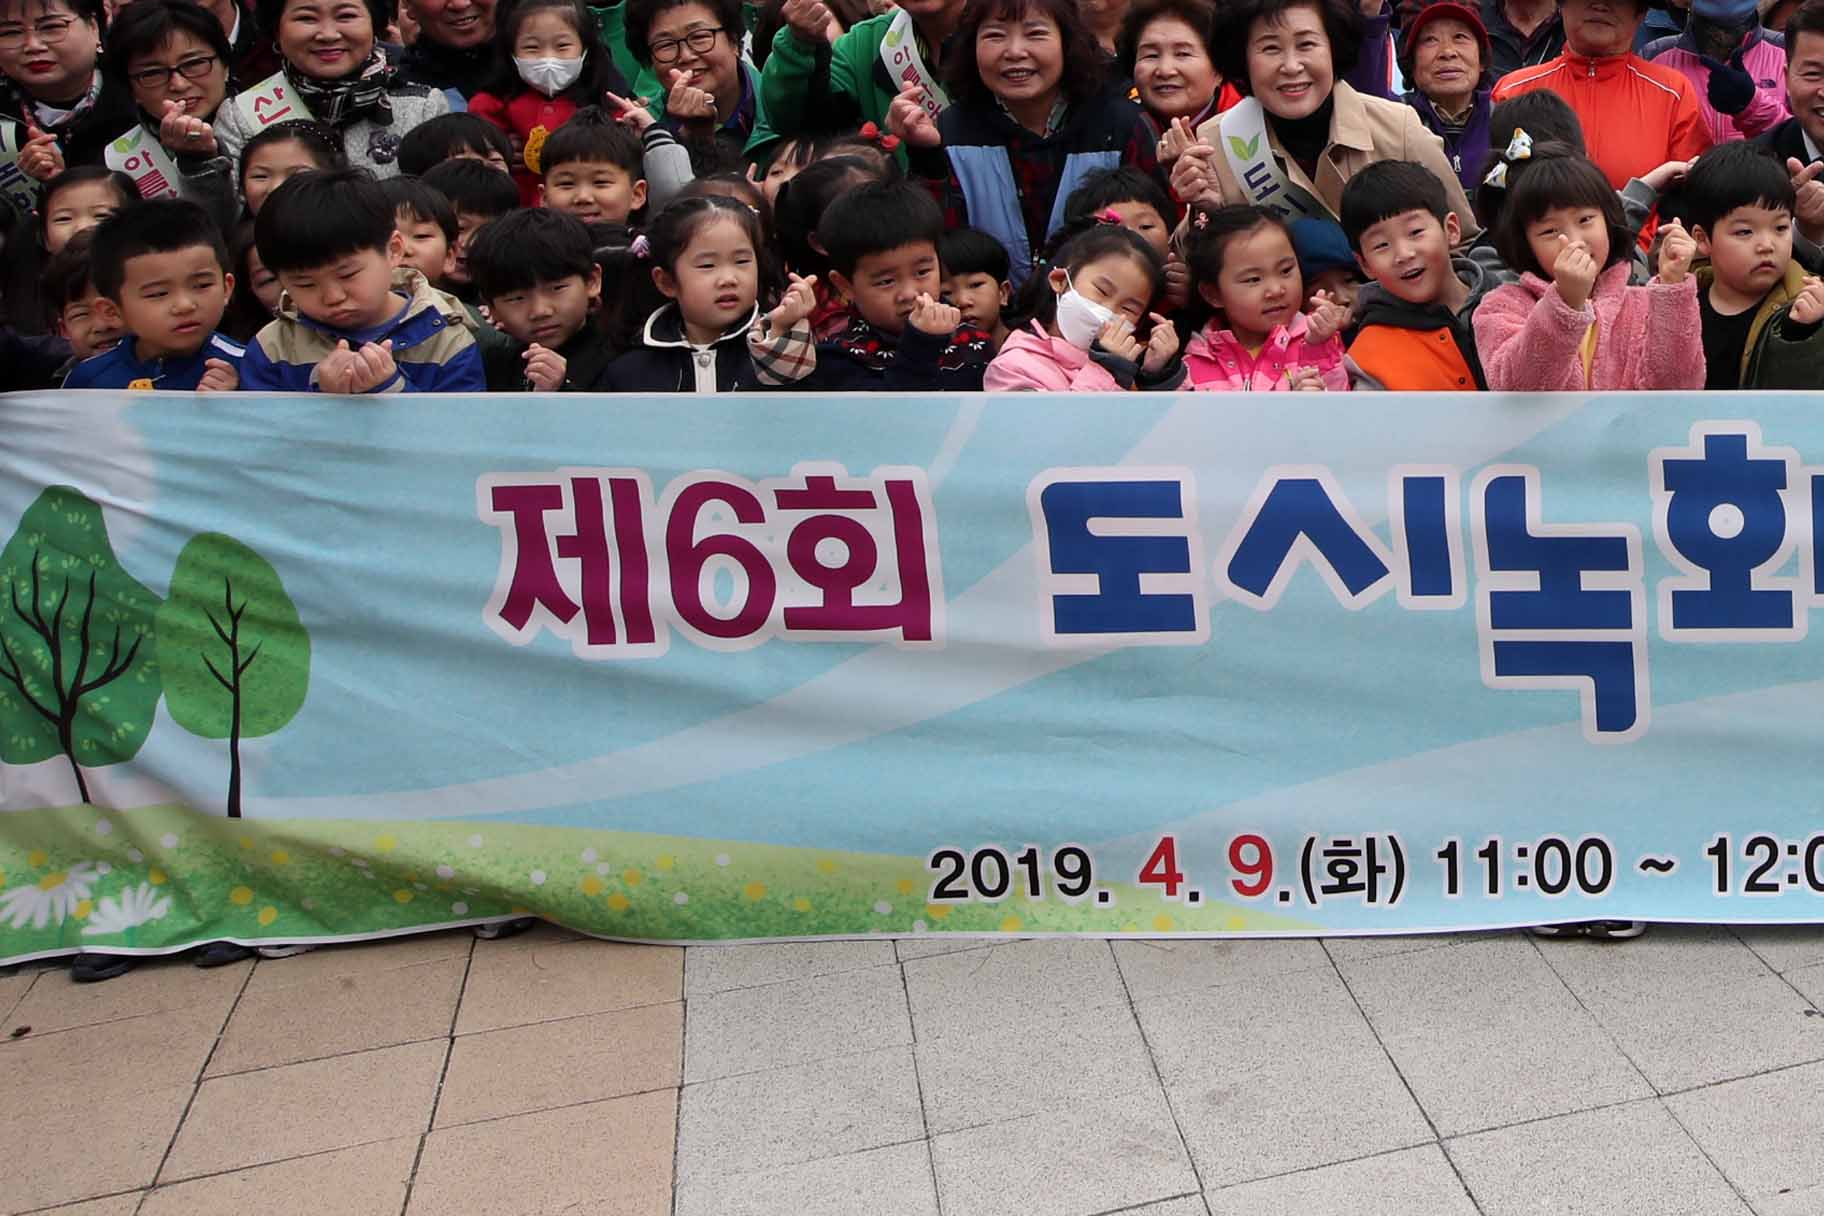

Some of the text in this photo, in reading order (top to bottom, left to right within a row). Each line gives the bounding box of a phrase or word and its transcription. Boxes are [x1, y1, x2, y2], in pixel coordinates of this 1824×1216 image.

[491, 475, 933, 646] 제6회
[930, 847, 1111, 904] 2019.
[1438, 838, 1614, 896] 11:00
